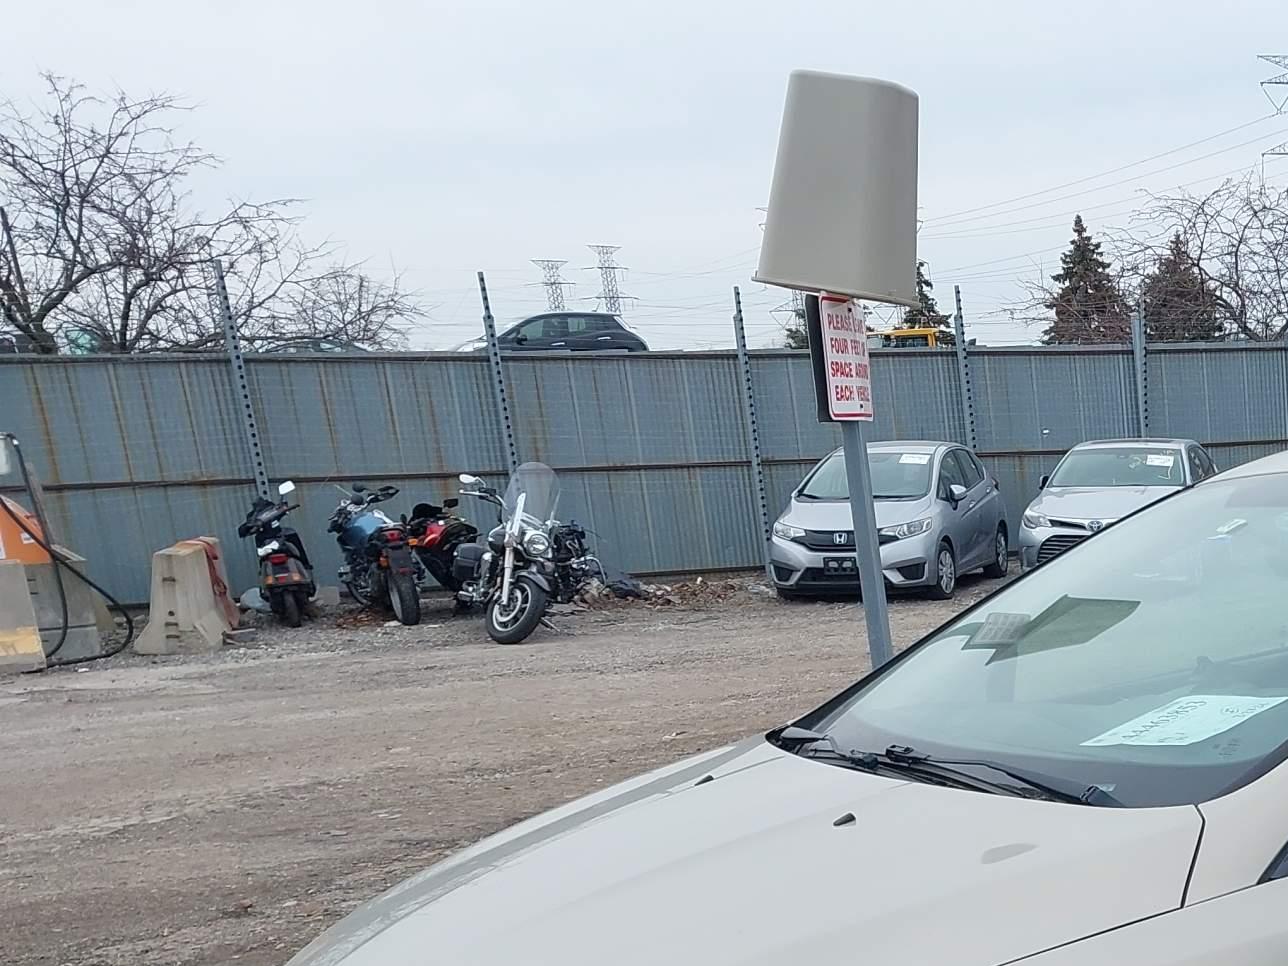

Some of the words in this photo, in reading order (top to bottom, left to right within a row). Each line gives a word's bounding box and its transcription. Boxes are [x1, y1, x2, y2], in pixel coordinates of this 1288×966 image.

[827, 312, 853, 332] PLEASE
[830, 336, 850, 354] FOUR
[830, 359, 854, 378] SPACE
[835, 384, 855, 402] EACH
